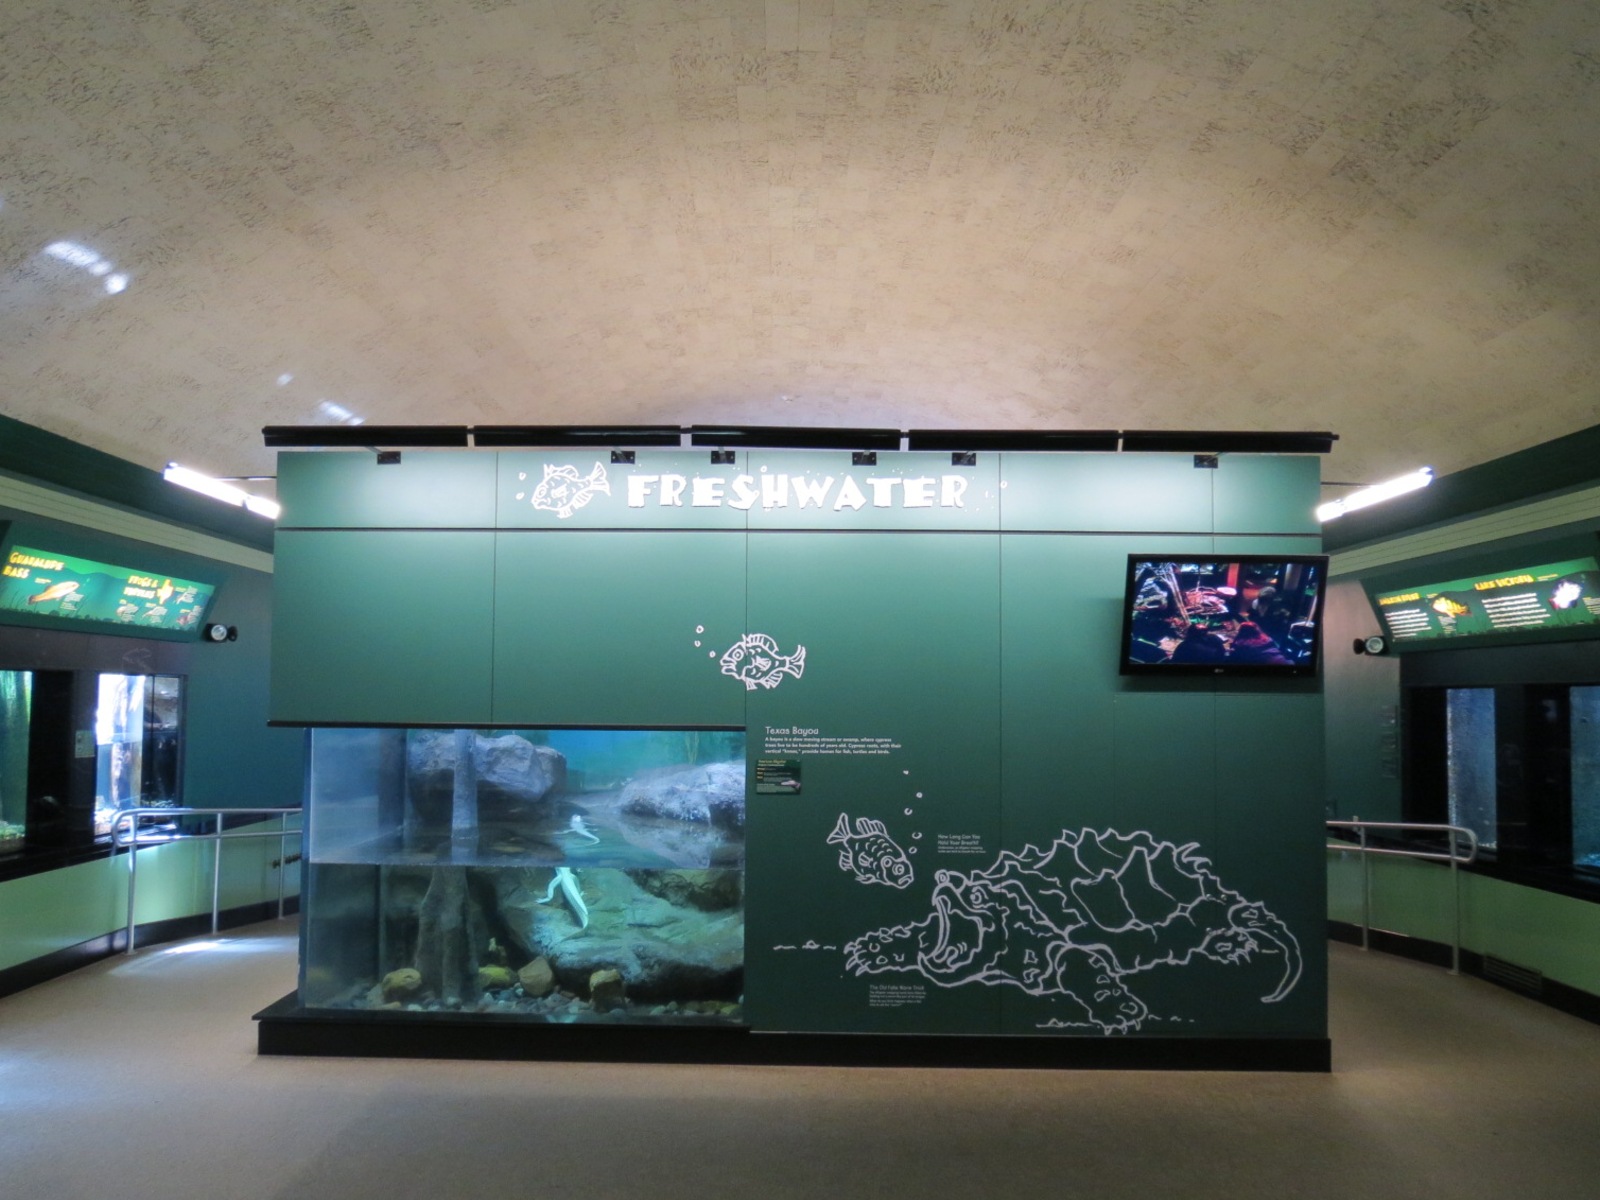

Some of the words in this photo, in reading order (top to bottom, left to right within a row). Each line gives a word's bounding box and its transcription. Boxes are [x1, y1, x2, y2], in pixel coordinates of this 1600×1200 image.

[627, 474, 968, 511] FRESHWATER
[2, 565, 30, 579] BASS
[765, 726, 790, 735] Texas
[792, 726, 819, 737] Bayou
